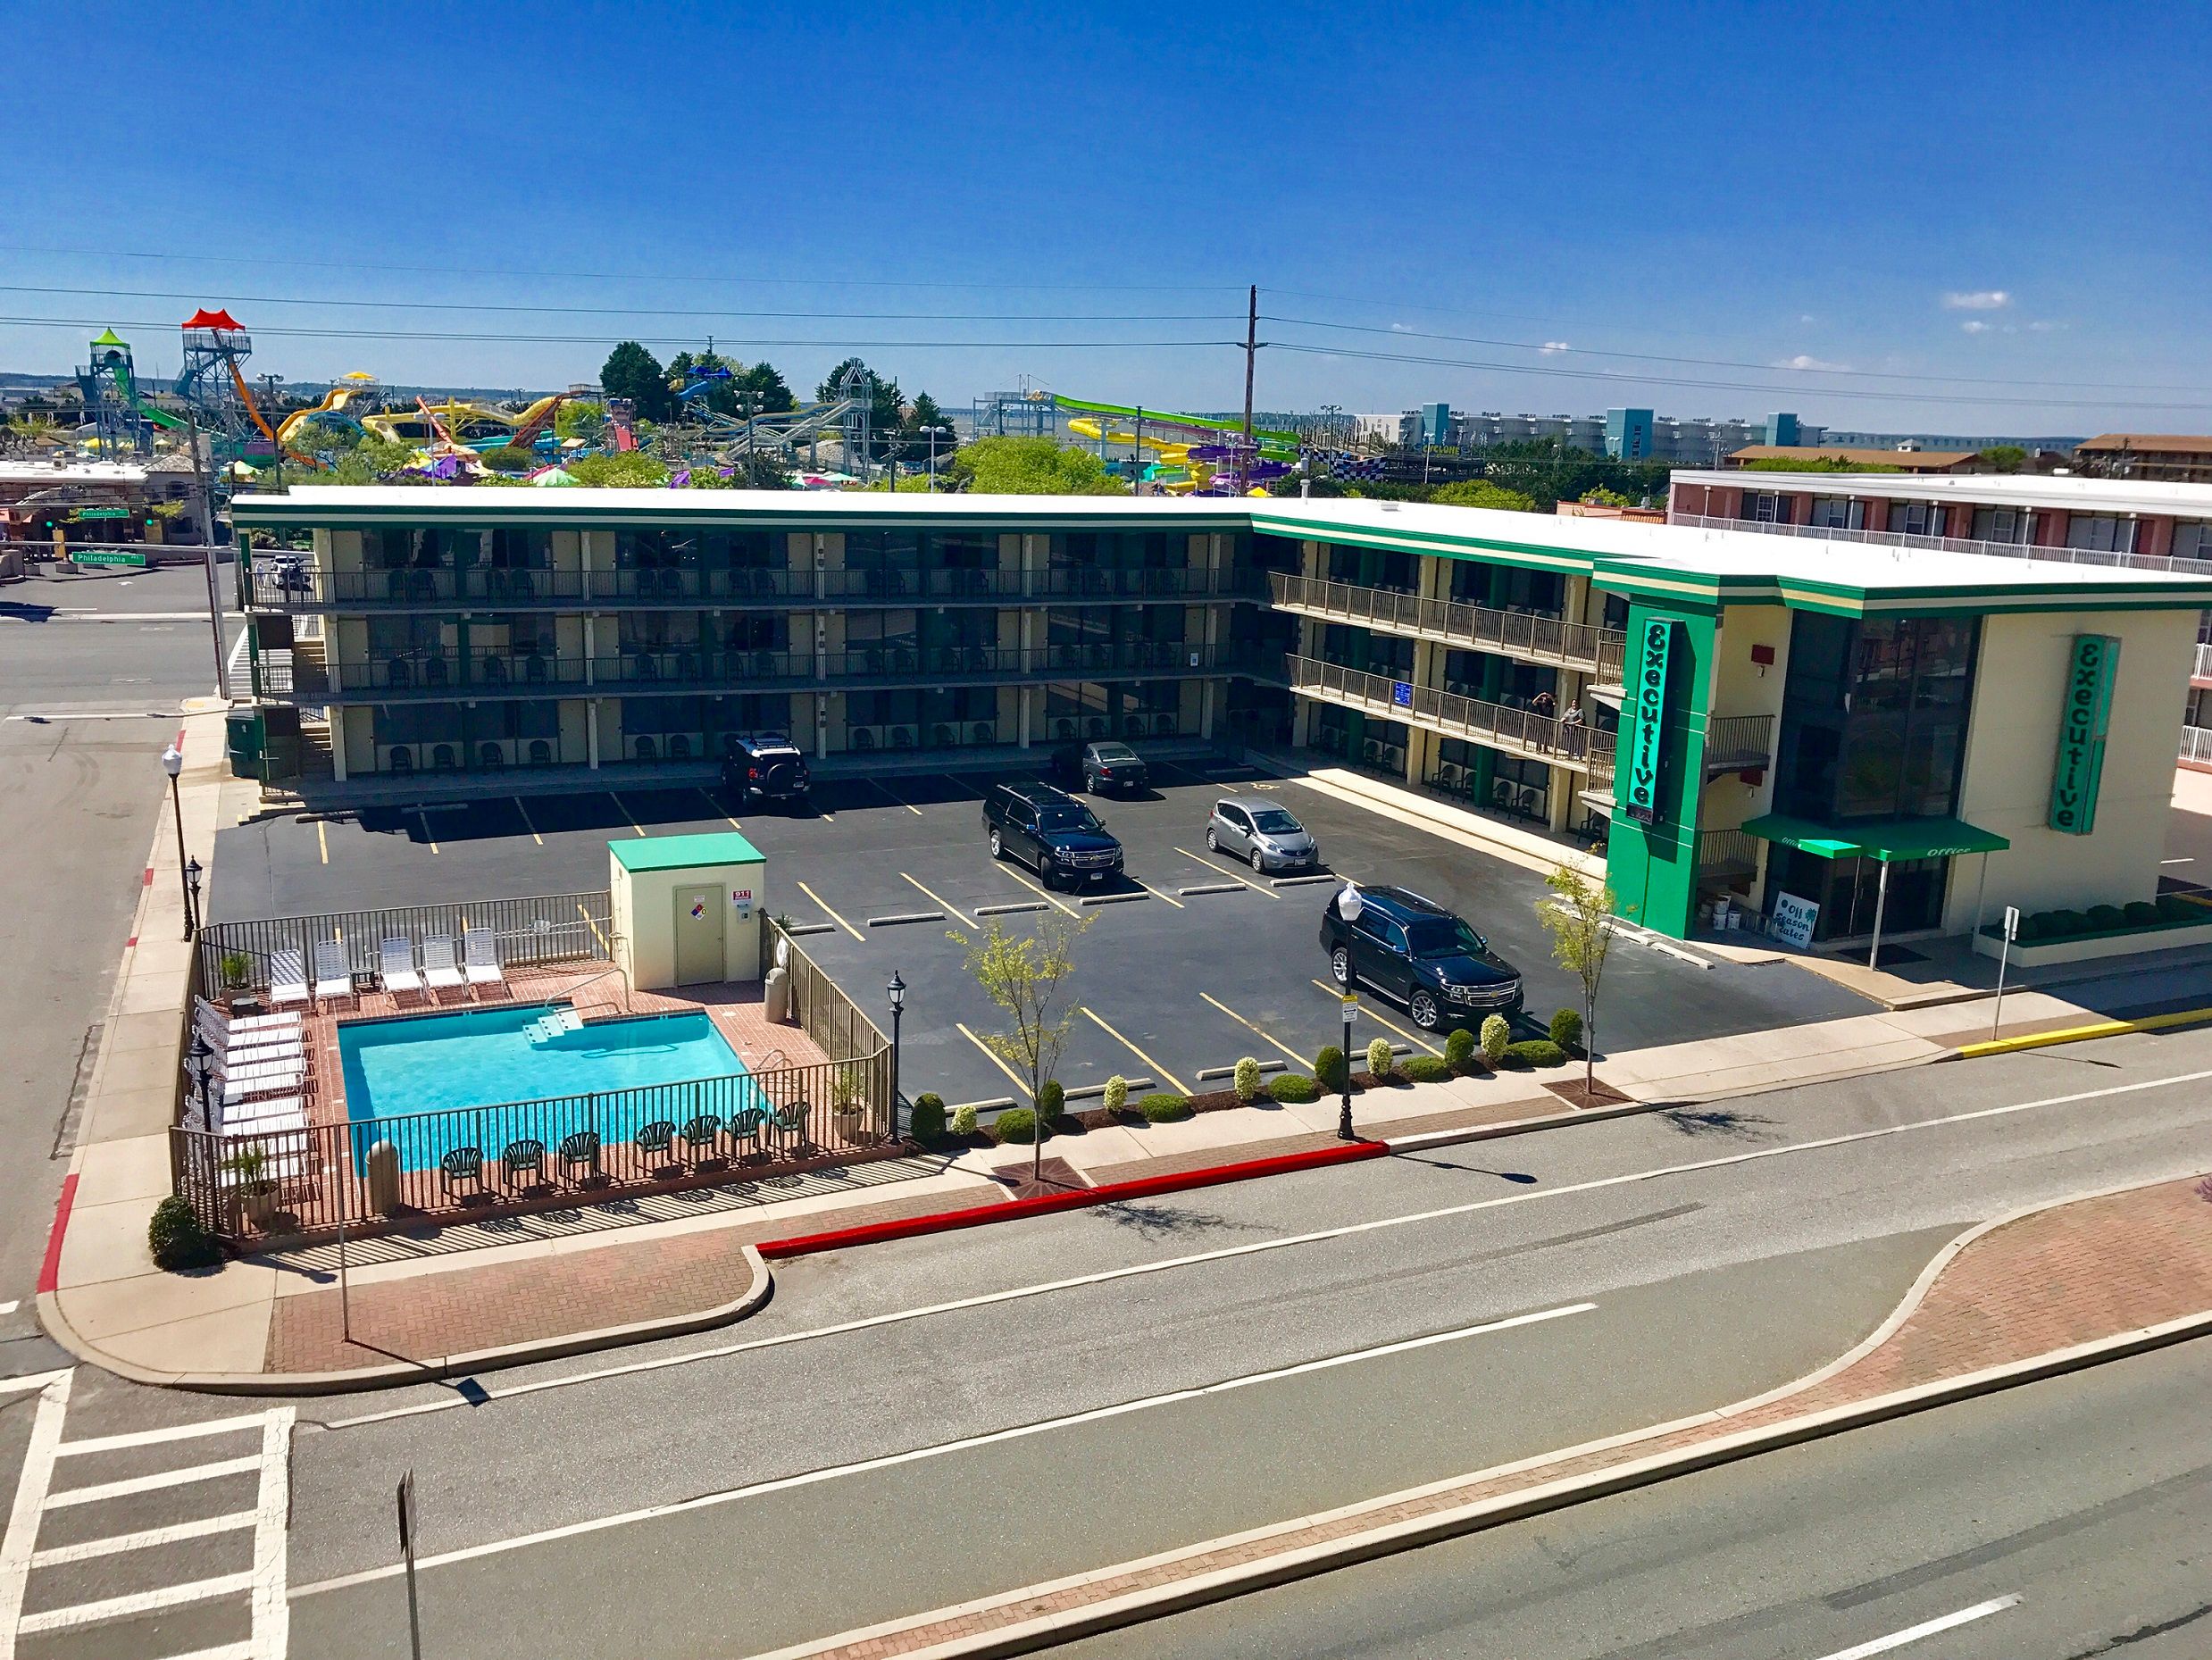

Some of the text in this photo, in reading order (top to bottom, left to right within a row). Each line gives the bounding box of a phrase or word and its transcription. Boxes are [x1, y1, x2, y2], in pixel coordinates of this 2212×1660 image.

[78, 555, 126, 563] Philadelphia
[1633, 623, 1666, 805] Executive
[2057, 643, 2099, 827] Executive
[1926, 847, 1972, 857] Office
